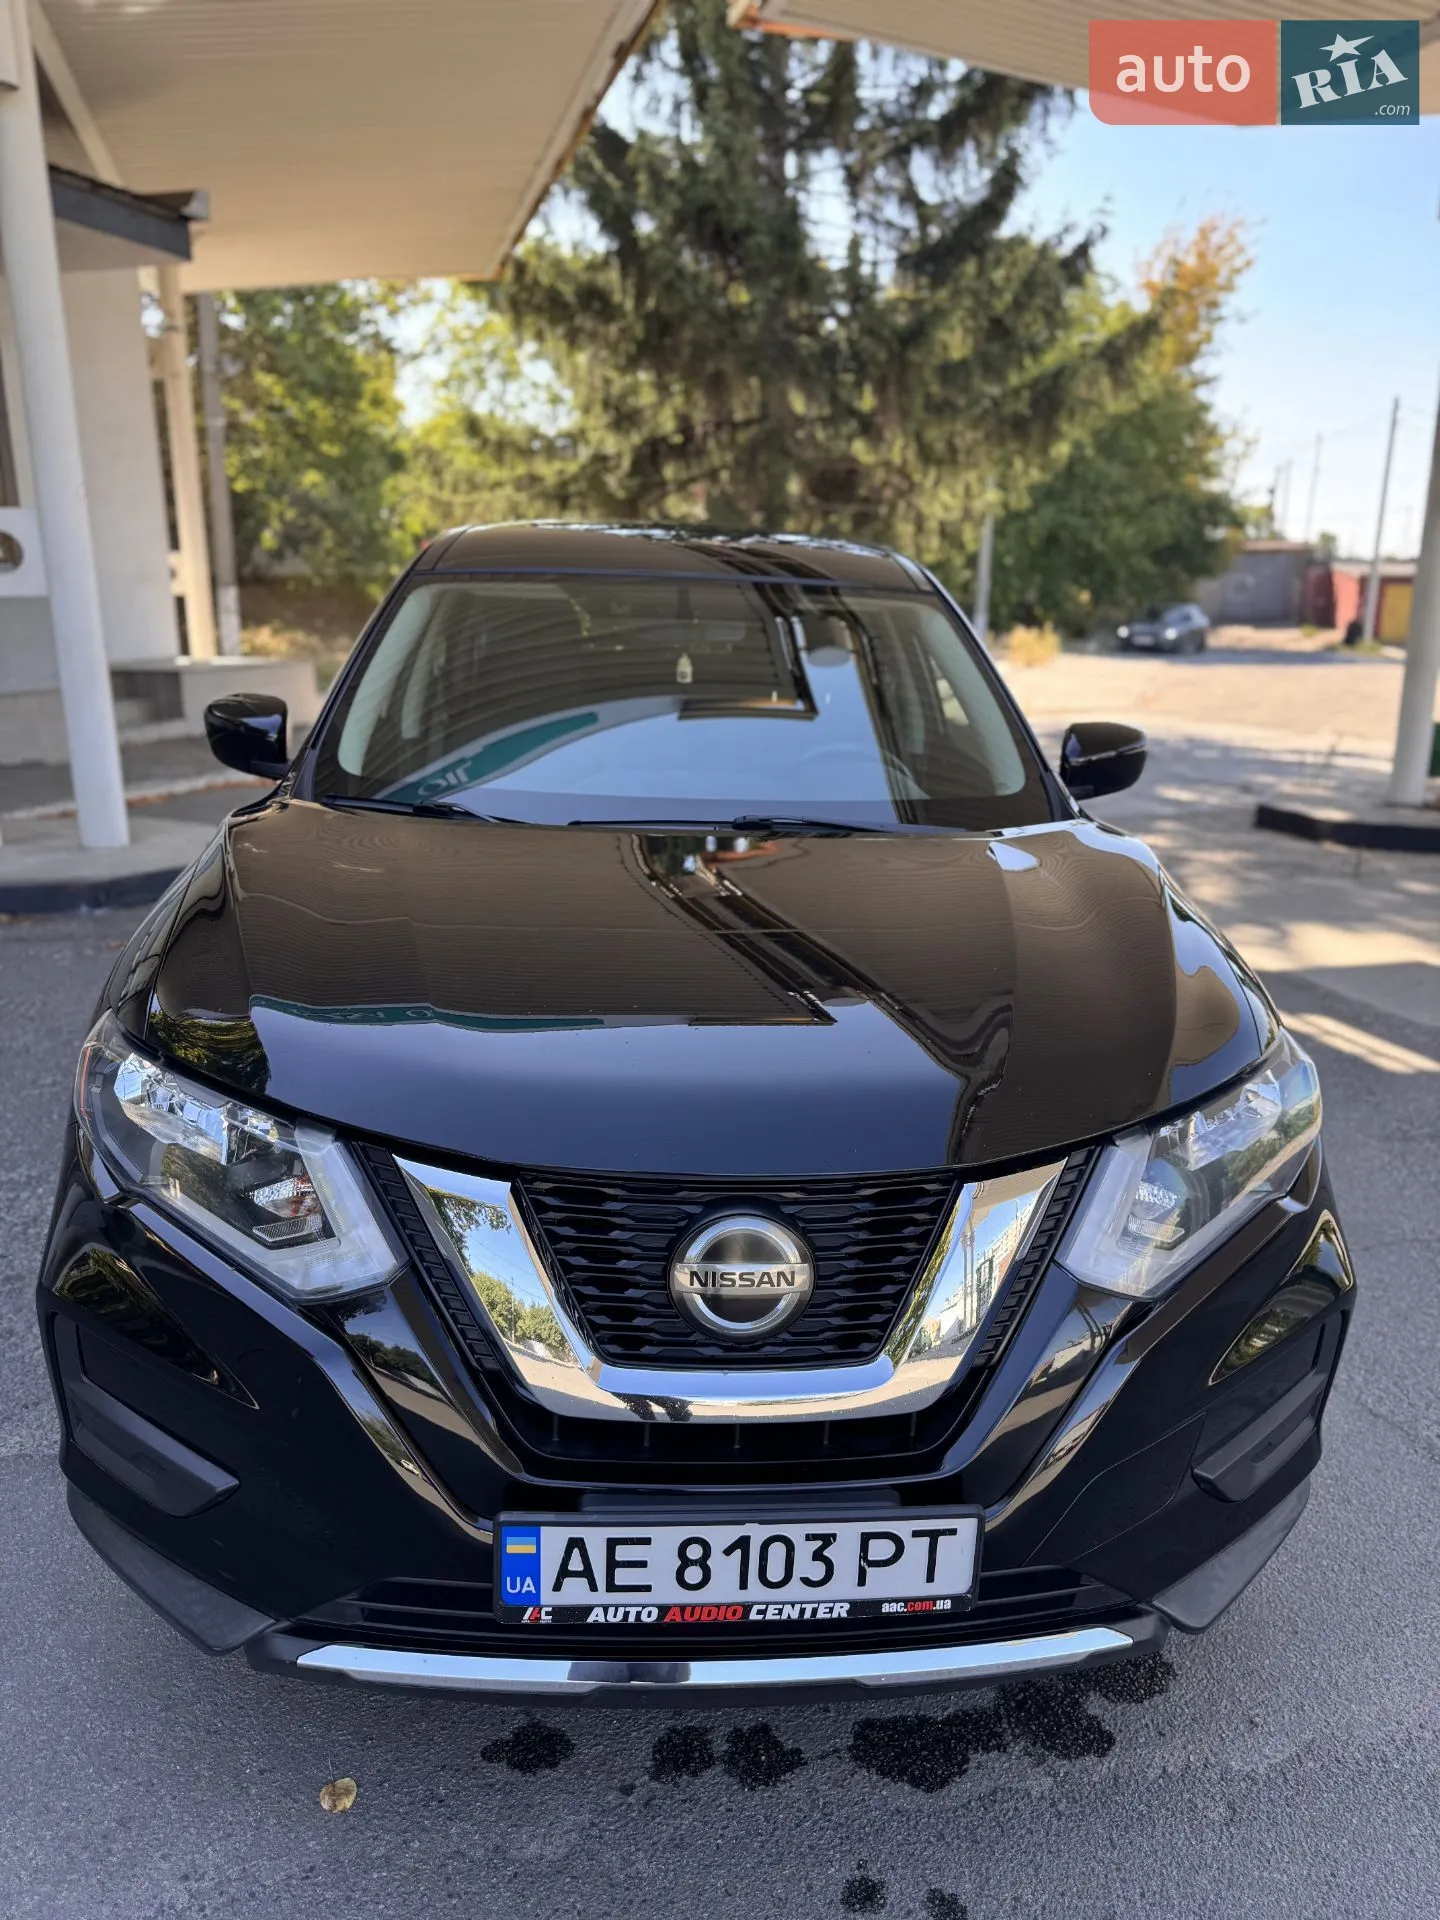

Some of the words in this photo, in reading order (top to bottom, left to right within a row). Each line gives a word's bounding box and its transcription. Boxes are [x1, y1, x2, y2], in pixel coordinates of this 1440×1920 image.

[689, 1270, 796, 1288] NISSAN
[551, 1536, 653, 1593] AE
[675, 1532, 838, 1592] 8103
[857, 1528, 958, 1587] PT
[506, 1576, 537, 1594] UA
[586, 1606, 659, 1623] AUTO
[663, 1605, 743, 1622] AUDIO
[748, 1602, 851, 1620] CENTER
[881, 1599, 952, 1613] aac.com.ua
